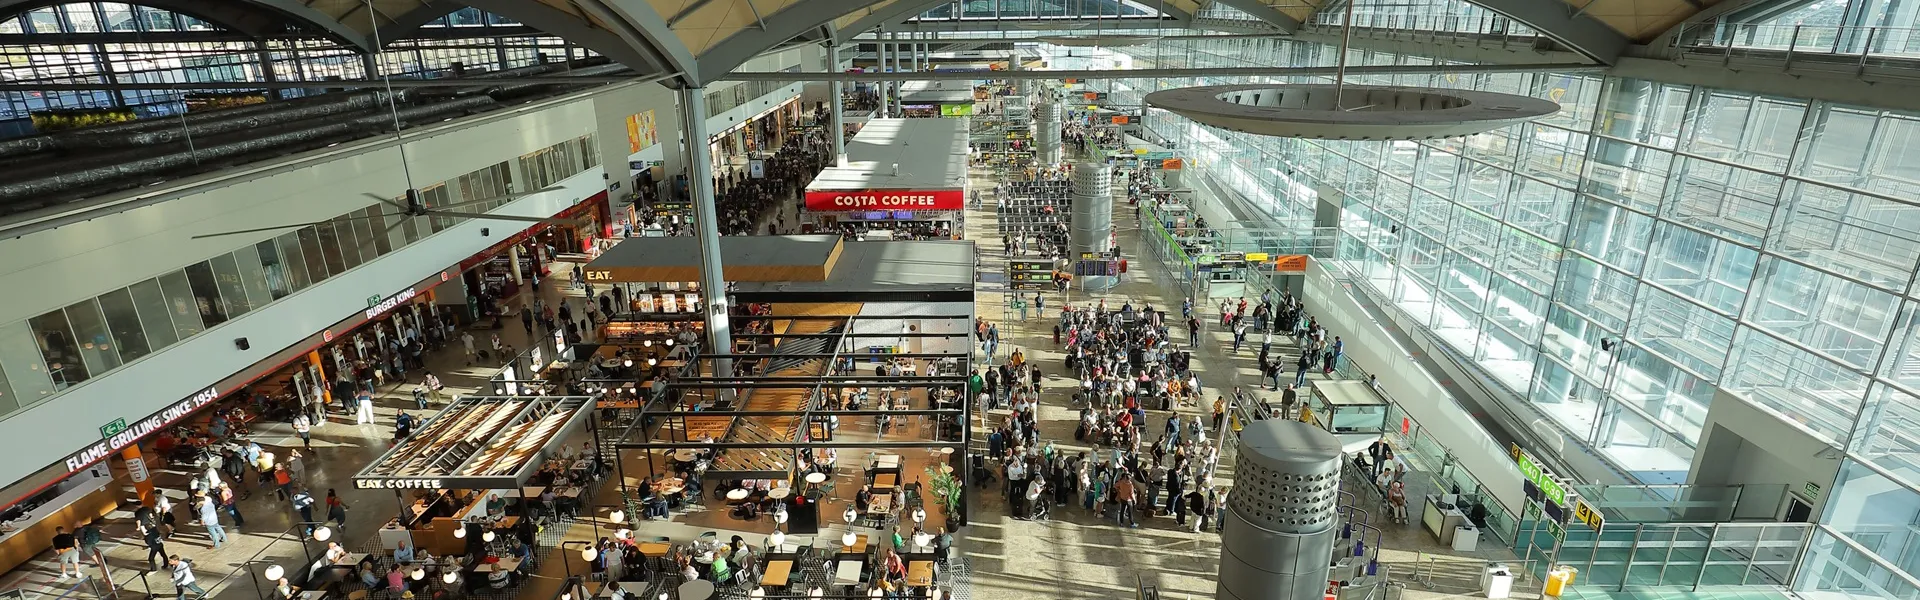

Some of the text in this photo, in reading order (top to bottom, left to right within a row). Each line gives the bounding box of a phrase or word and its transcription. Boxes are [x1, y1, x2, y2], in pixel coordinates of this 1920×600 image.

[834, 195, 935, 207] COSTA COFFEE
[586, 271, 613, 280] EAT.
[365, 287, 416, 320] BURGER KING
[65, 387, 219, 472] FLAME GRILLING SINCE 1954
[1522, 460, 1538, 480] C40
[356, 479, 442, 489] EAT. COFFEE
[1544, 480, 1561, 500] C39
